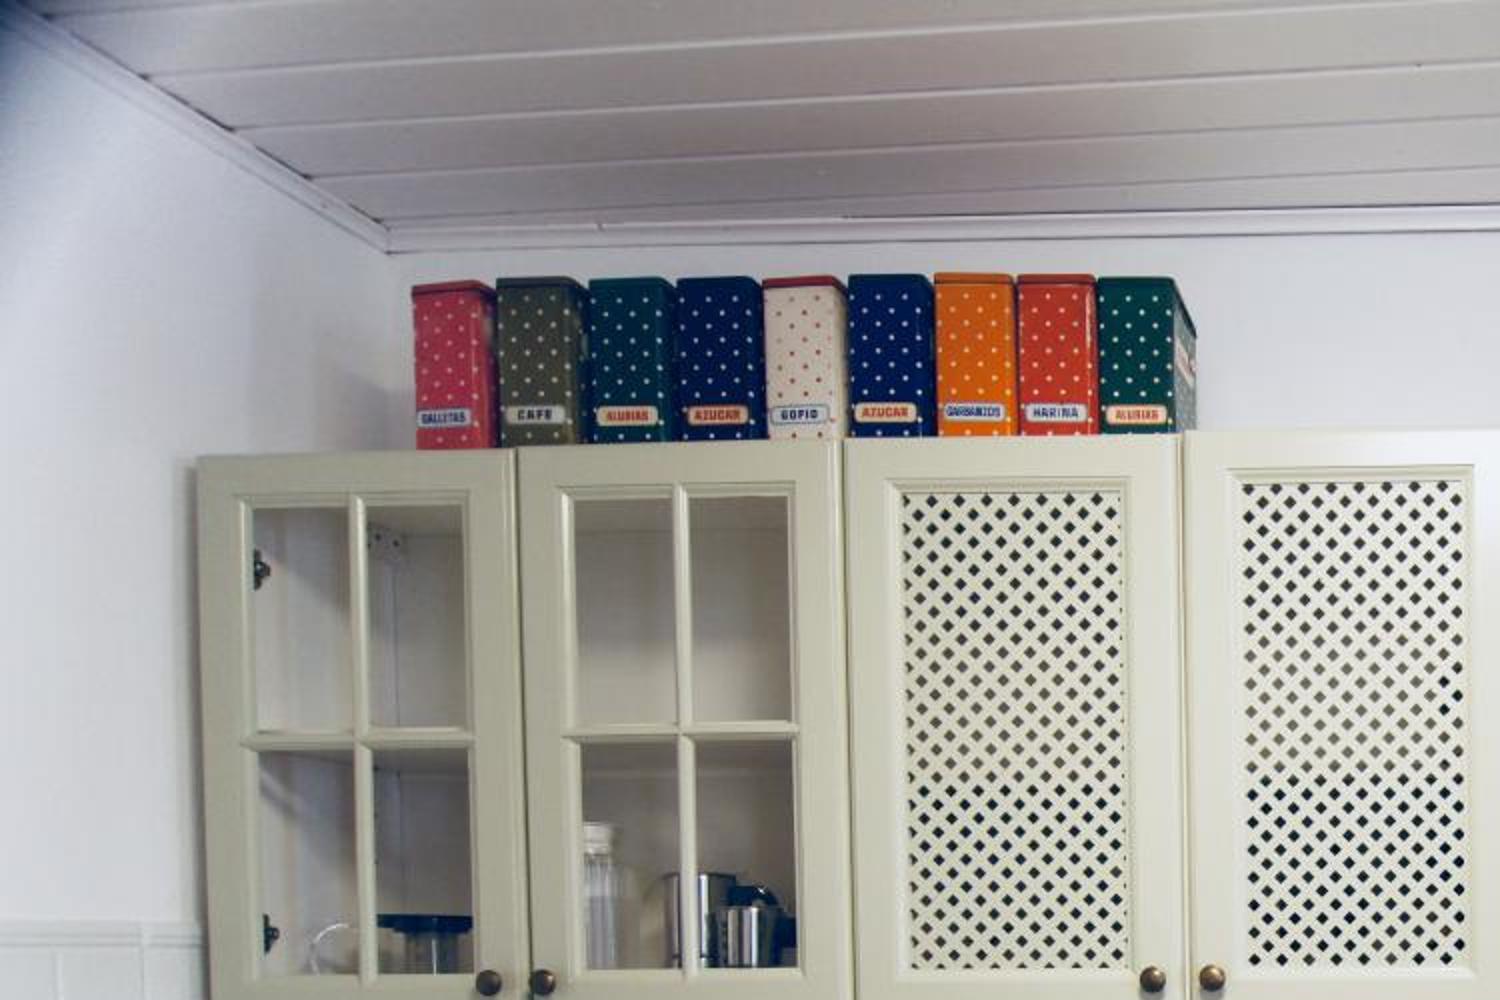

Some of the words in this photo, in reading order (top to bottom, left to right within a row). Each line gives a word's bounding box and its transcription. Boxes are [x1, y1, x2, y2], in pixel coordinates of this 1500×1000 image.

[693, 409, 741, 421] AZUCAR
[780, 408, 819, 421] GOFIO
[861, 406, 909, 418] AZUCAR
[1032, 407, 1079, 418] HARINA
